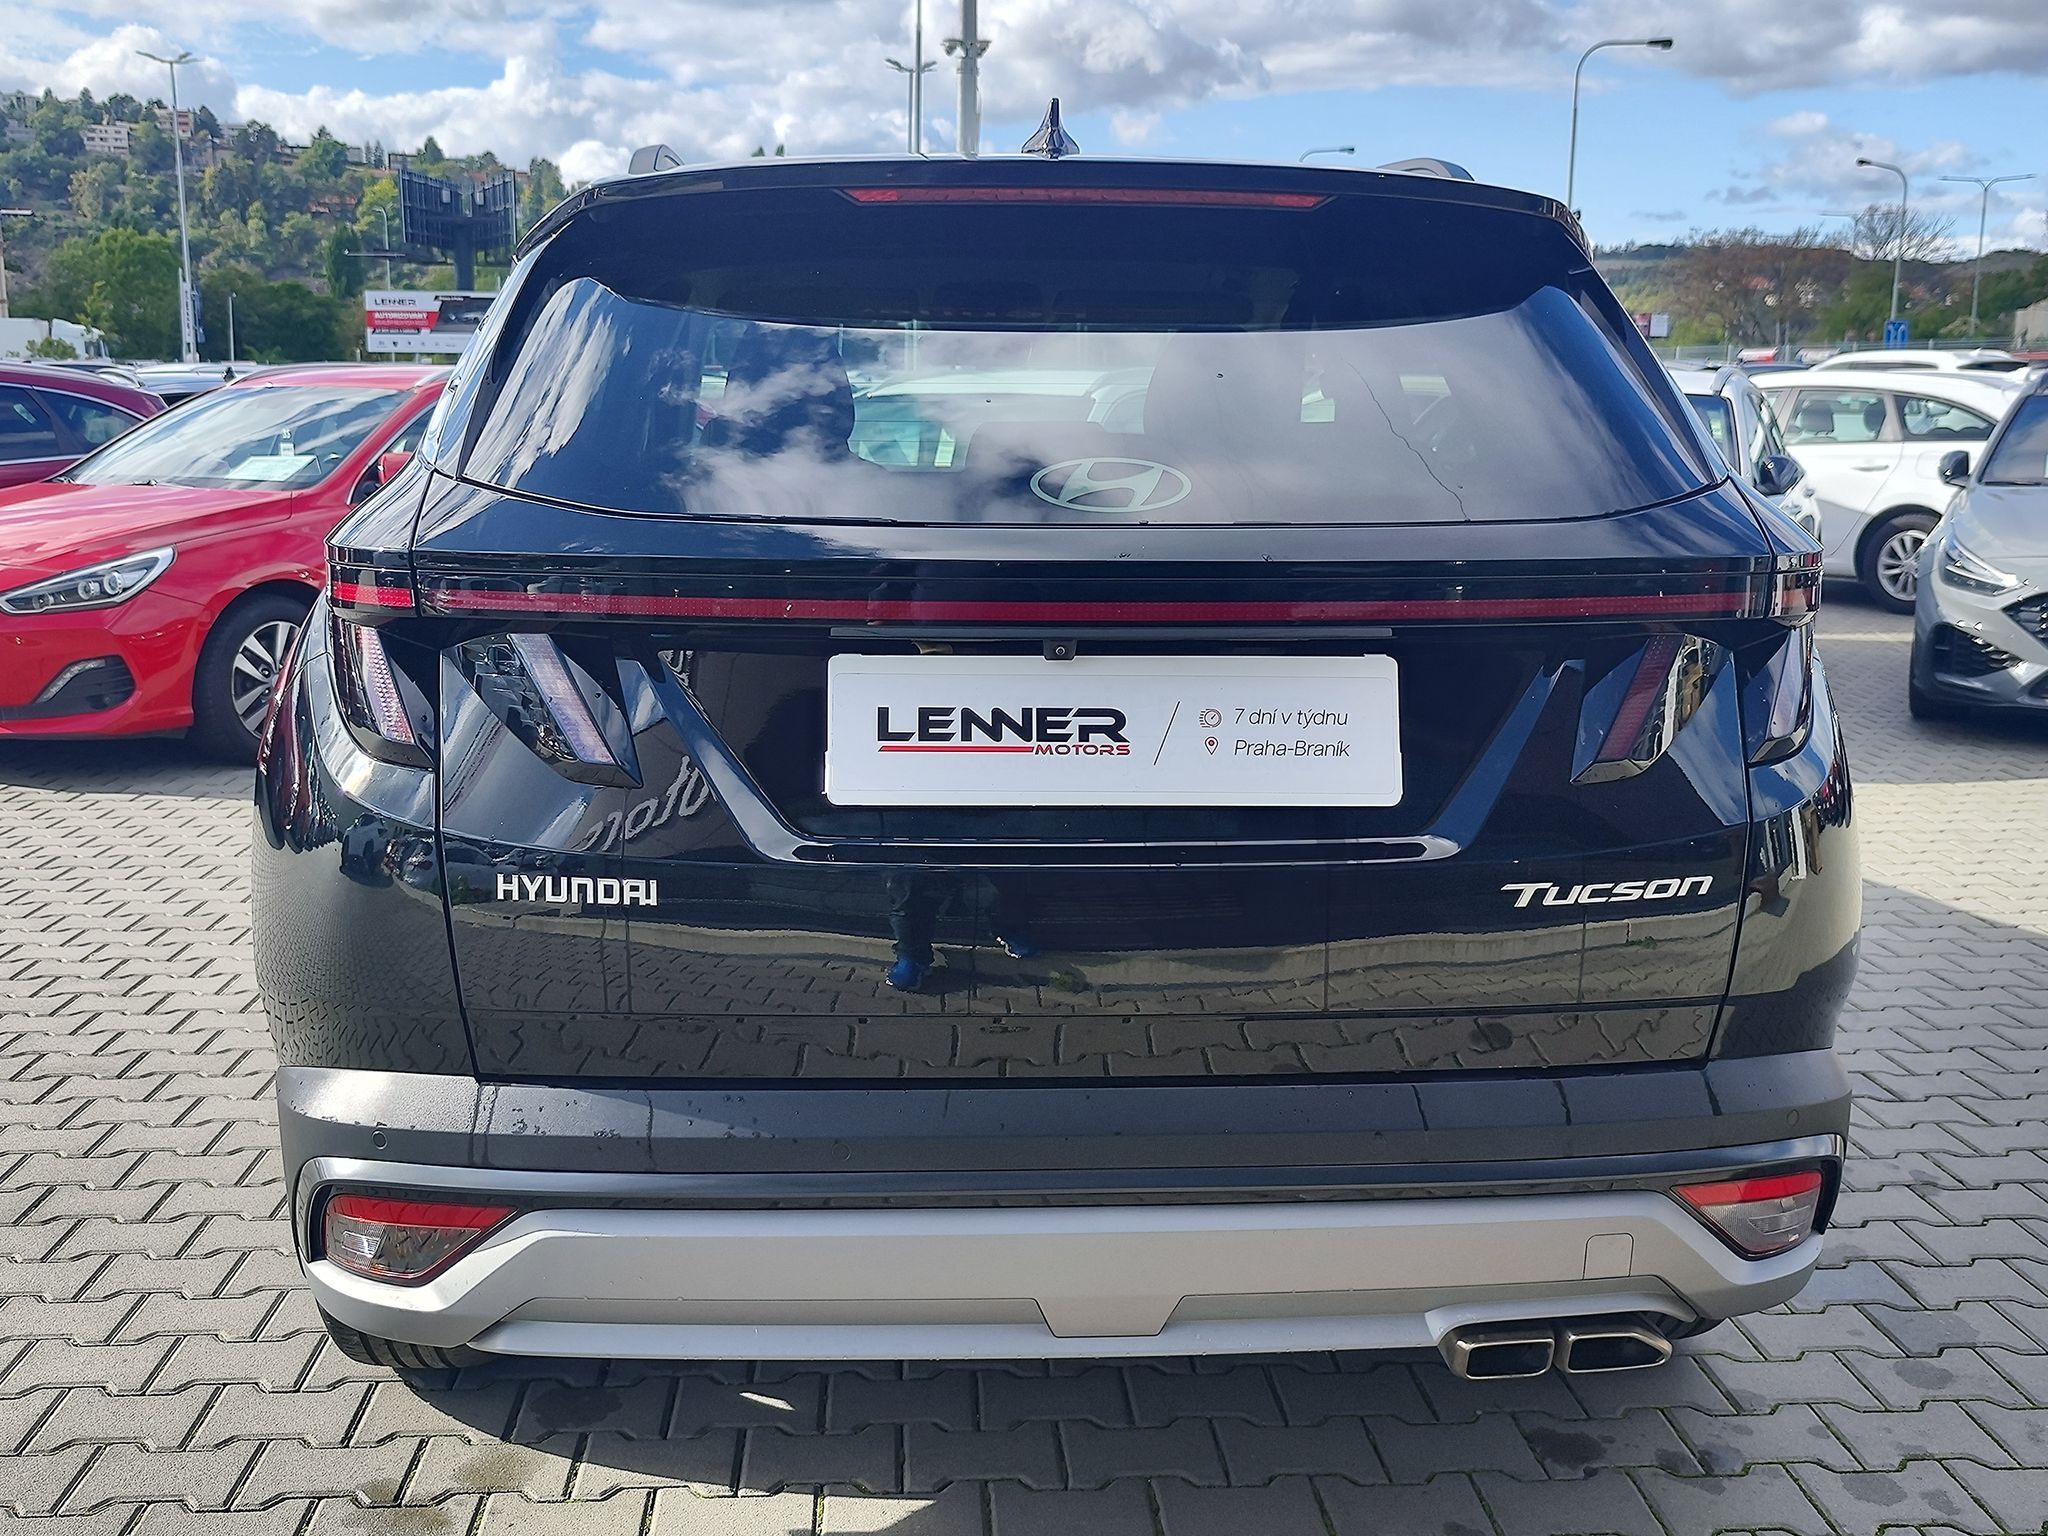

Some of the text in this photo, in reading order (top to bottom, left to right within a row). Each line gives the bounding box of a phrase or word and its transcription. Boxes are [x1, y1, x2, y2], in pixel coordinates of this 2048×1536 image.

[877, 706, 1130, 743] LENNER
[1235, 708, 1349, 729] 7 dní v týdnu
[1034, 744, 1131, 756] MOTORS
[1234, 739, 1351, 757] Praha-Braník
[496, 873, 658, 906] HYUNDAI
